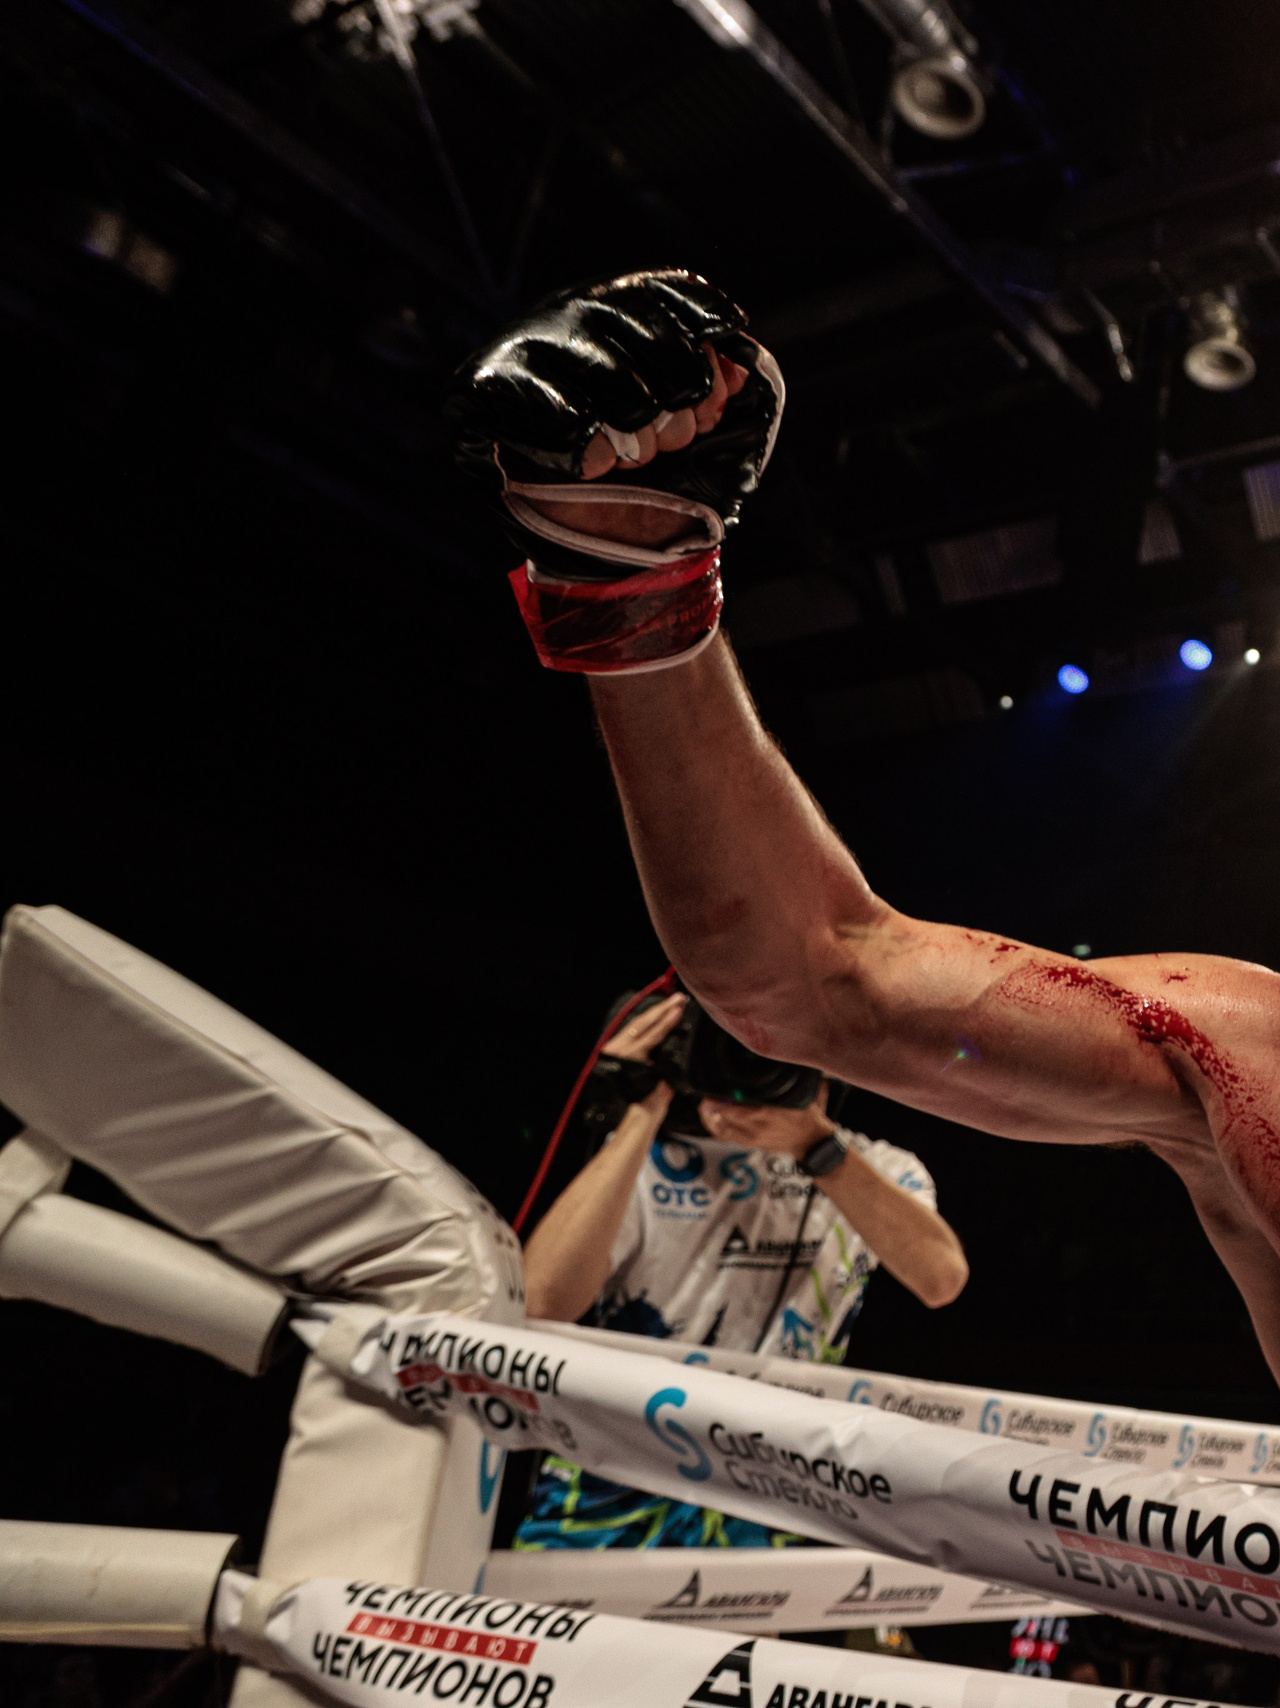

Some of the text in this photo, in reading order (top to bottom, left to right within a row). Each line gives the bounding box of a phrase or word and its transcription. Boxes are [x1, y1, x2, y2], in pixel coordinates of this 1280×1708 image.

[344, 1580, 597, 1642] ЧЕМПИОНЫ
[354, 1615, 528, 1661] ВЫЗЫВАЮТ
[312, 1630, 555, 1708] ЧЕМПИОНОВ
